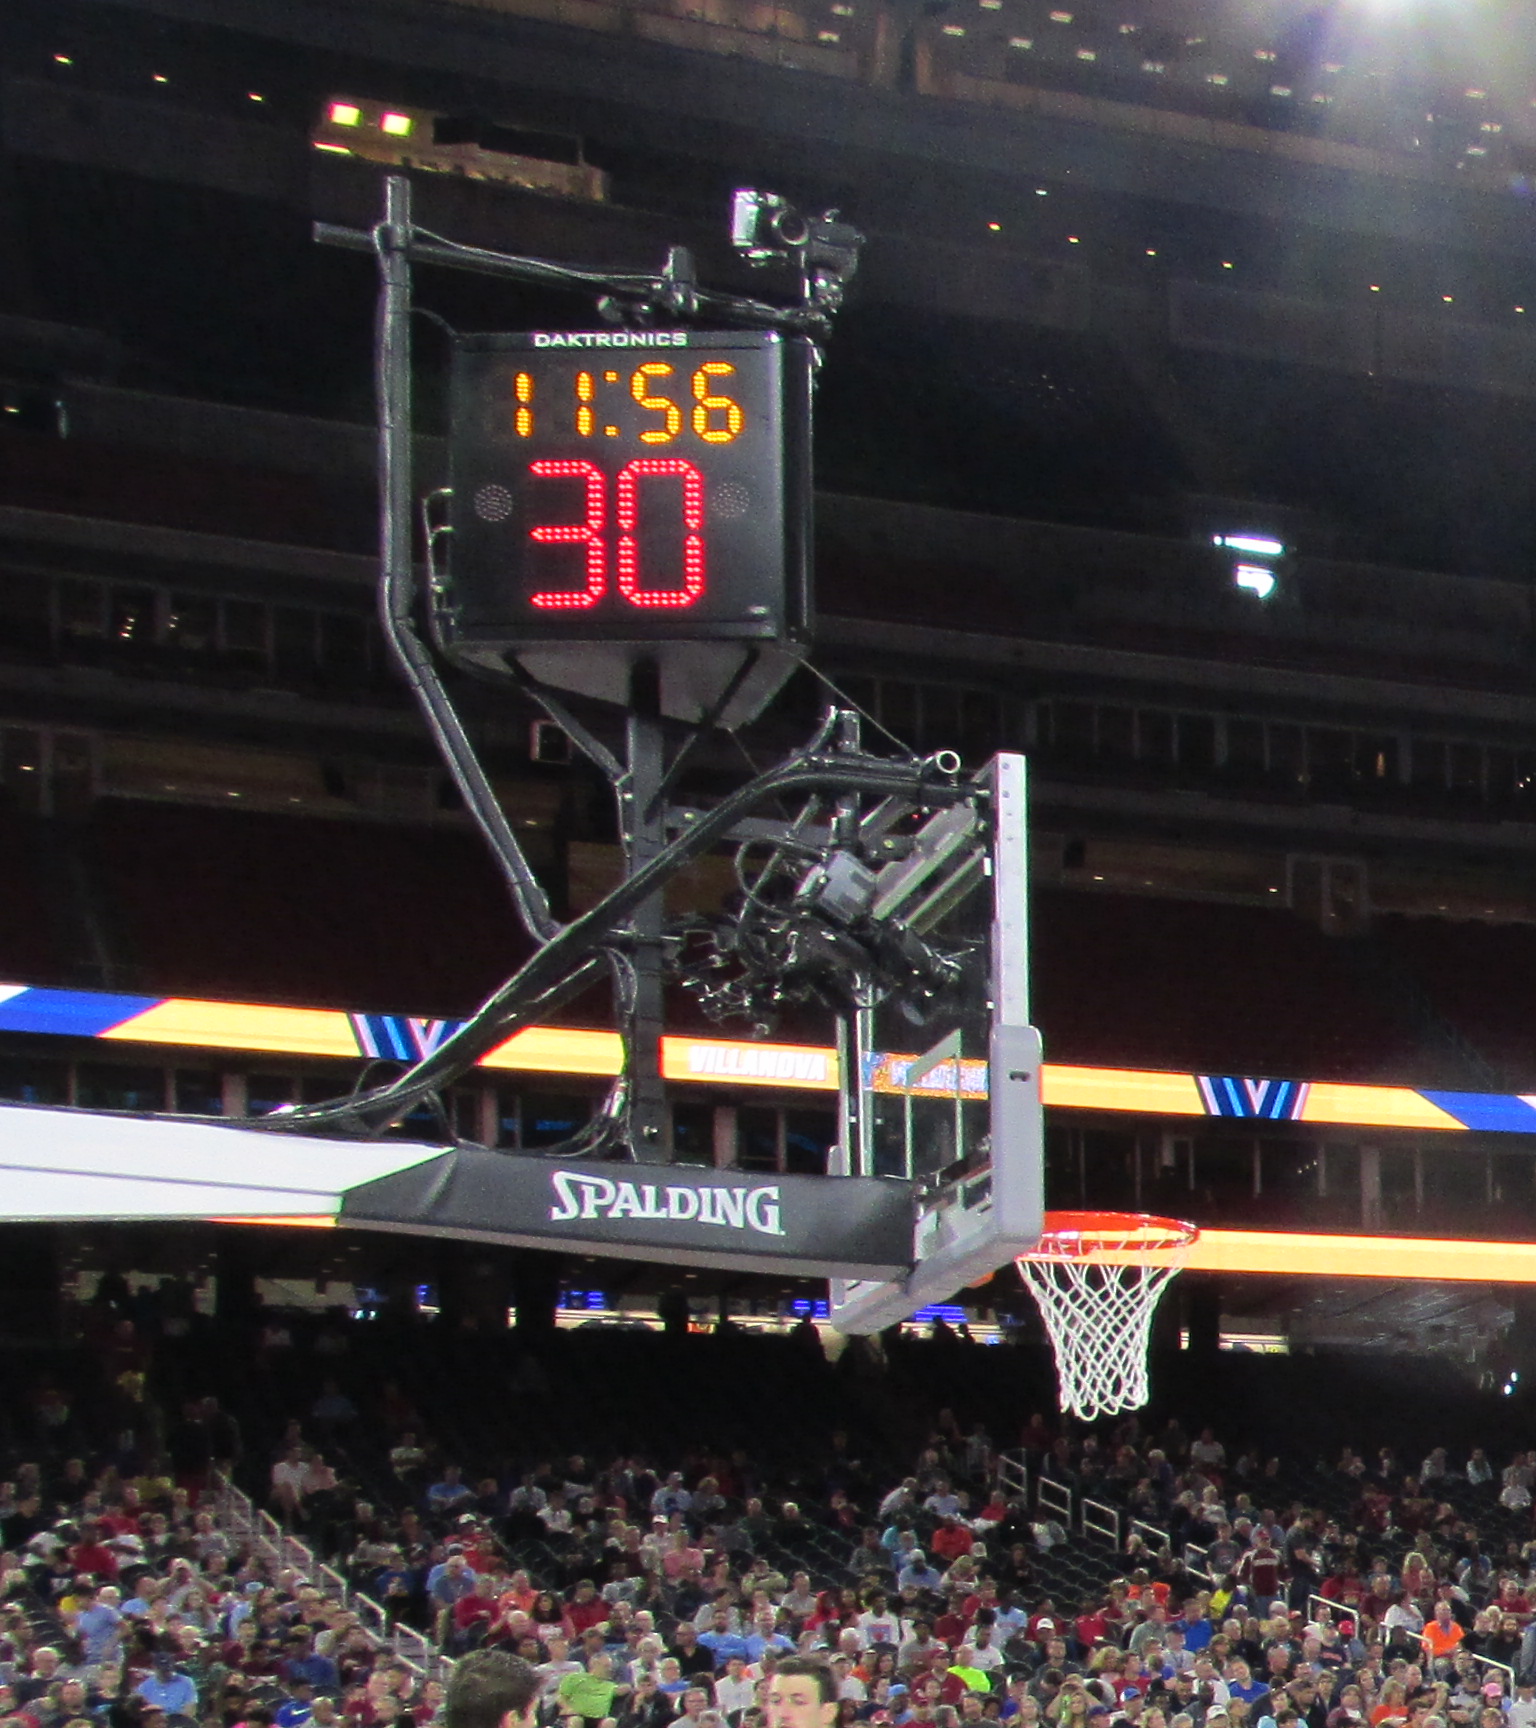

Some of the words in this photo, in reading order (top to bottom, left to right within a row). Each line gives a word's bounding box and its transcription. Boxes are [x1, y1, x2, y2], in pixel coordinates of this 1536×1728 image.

[533, 332, 688, 348] DAKTRONICS
[513, 362, 745, 445] 11:56
[530, 458, 706, 608] 30
[688, 1043, 826, 1081] VILLANOVA
[549, 1169, 786, 1236] SPALDING
